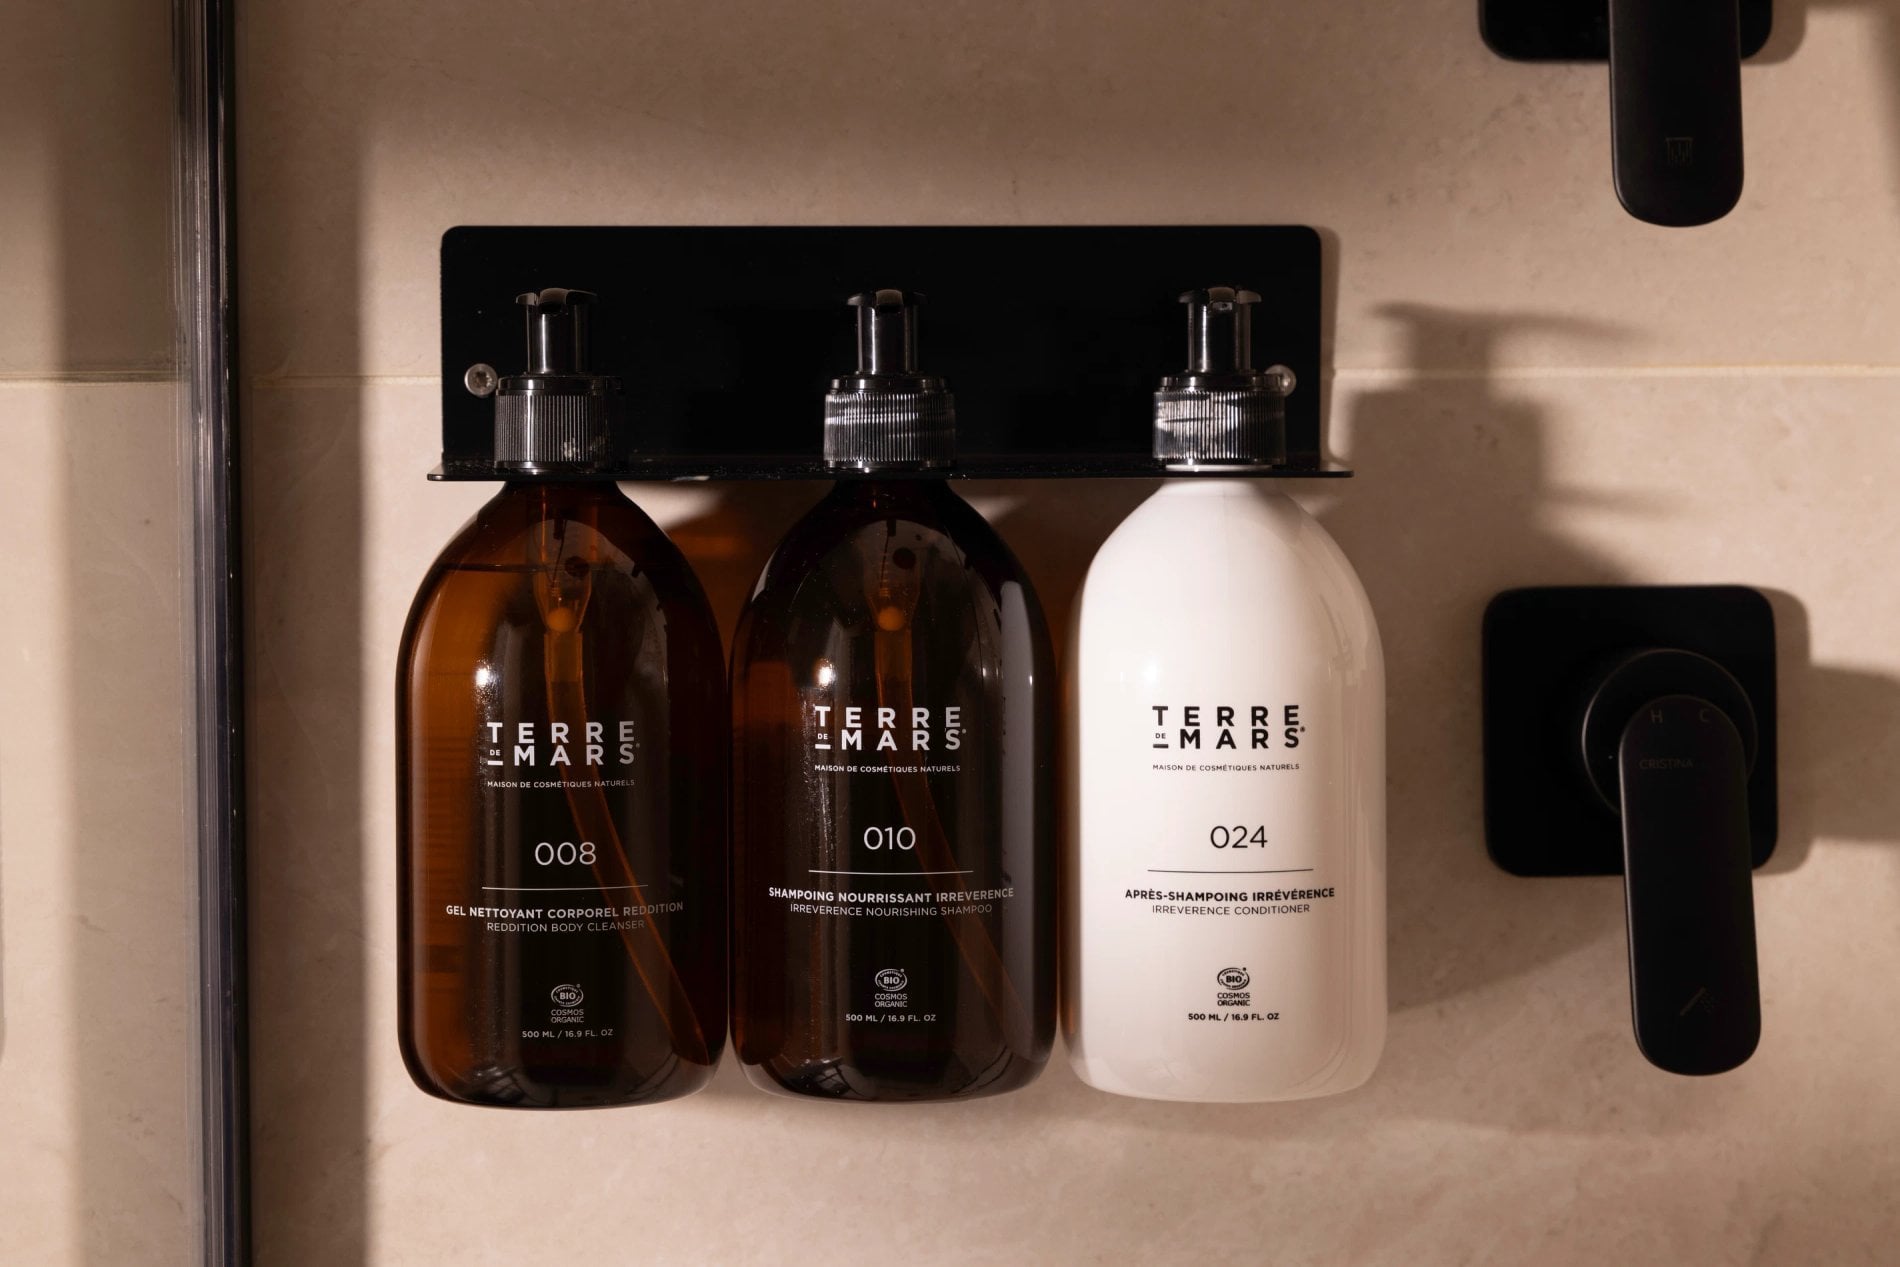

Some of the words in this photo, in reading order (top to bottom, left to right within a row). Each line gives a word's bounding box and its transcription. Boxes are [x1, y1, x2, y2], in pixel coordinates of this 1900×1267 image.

[814, 706, 961, 728] TERRE
[1152, 705, 1299, 726] TERRE
[1651, 709, 1663, 724] H
[1699, 708, 1711, 723] C
[486, 721, 634, 743] TERRE
[814, 764, 844, 772] MAISON
[860, 765, 918, 773] COSMÉTIQUES
[1639, 758, 1694, 770] CRISTINA
[594, 779, 635, 787] NATURELS
[863, 826, 916, 850] 010
[1210, 825, 1268, 849] 024
[534, 842, 597, 865] 008
[769, 887, 834, 901] SHAMPOING
[838, 892, 932, 903] NOURRISSANT
[936, 888, 1014, 902] IRREVERENCE
[1125, 888, 1248, 901] APRÈS-SHAMPOING
[1252, 888, 1335, 901] IRRÉVÉRENCE
[446, 905, 466, 916] GEL
[469, 907, 543, 919] NETTOYANT
[547, 908, 619, 919] CORPOREL
[623, 901, 684, 916] REDDITION
[790, 903, 863, 916] IRREVERENCE
[866, 906, 937, 917] NOURISHING
[940, 904, 993, 915] SHAMPOO
[1152, 905, 1230, 915] IRREVERENCE
[1234, 904, 1310, 915] CONDITIONER
[487, 922, 547, 932] REDDITION
[551, 923, 584, 932] BODY
[587, 920, 645, 932] CLEANSER
[883, 976, 900, 985] BIO
[1225, 975, 1243, 984] BIO
[559, 992, 576, 1000] BIO
[874, 993, 908, 1001] COSMOS
[1217, 992, 1251, 1000] COSMOS
[874, 1000, 908, 1008] ORGANIC
[1217, 999, 1251, 1007] ORGANIC
[845, 1013, 862, 1021] 500
[880, 1014, 885, 1023] /
[1188, 1013, 1206, 1021] 500
[1208, 1013, 1221, 1021] ML
[1224, 1013, 1229, 1022] /
[557, 1030, 563, 1039] /
[565, 1030, 583, 1038] 16.9
